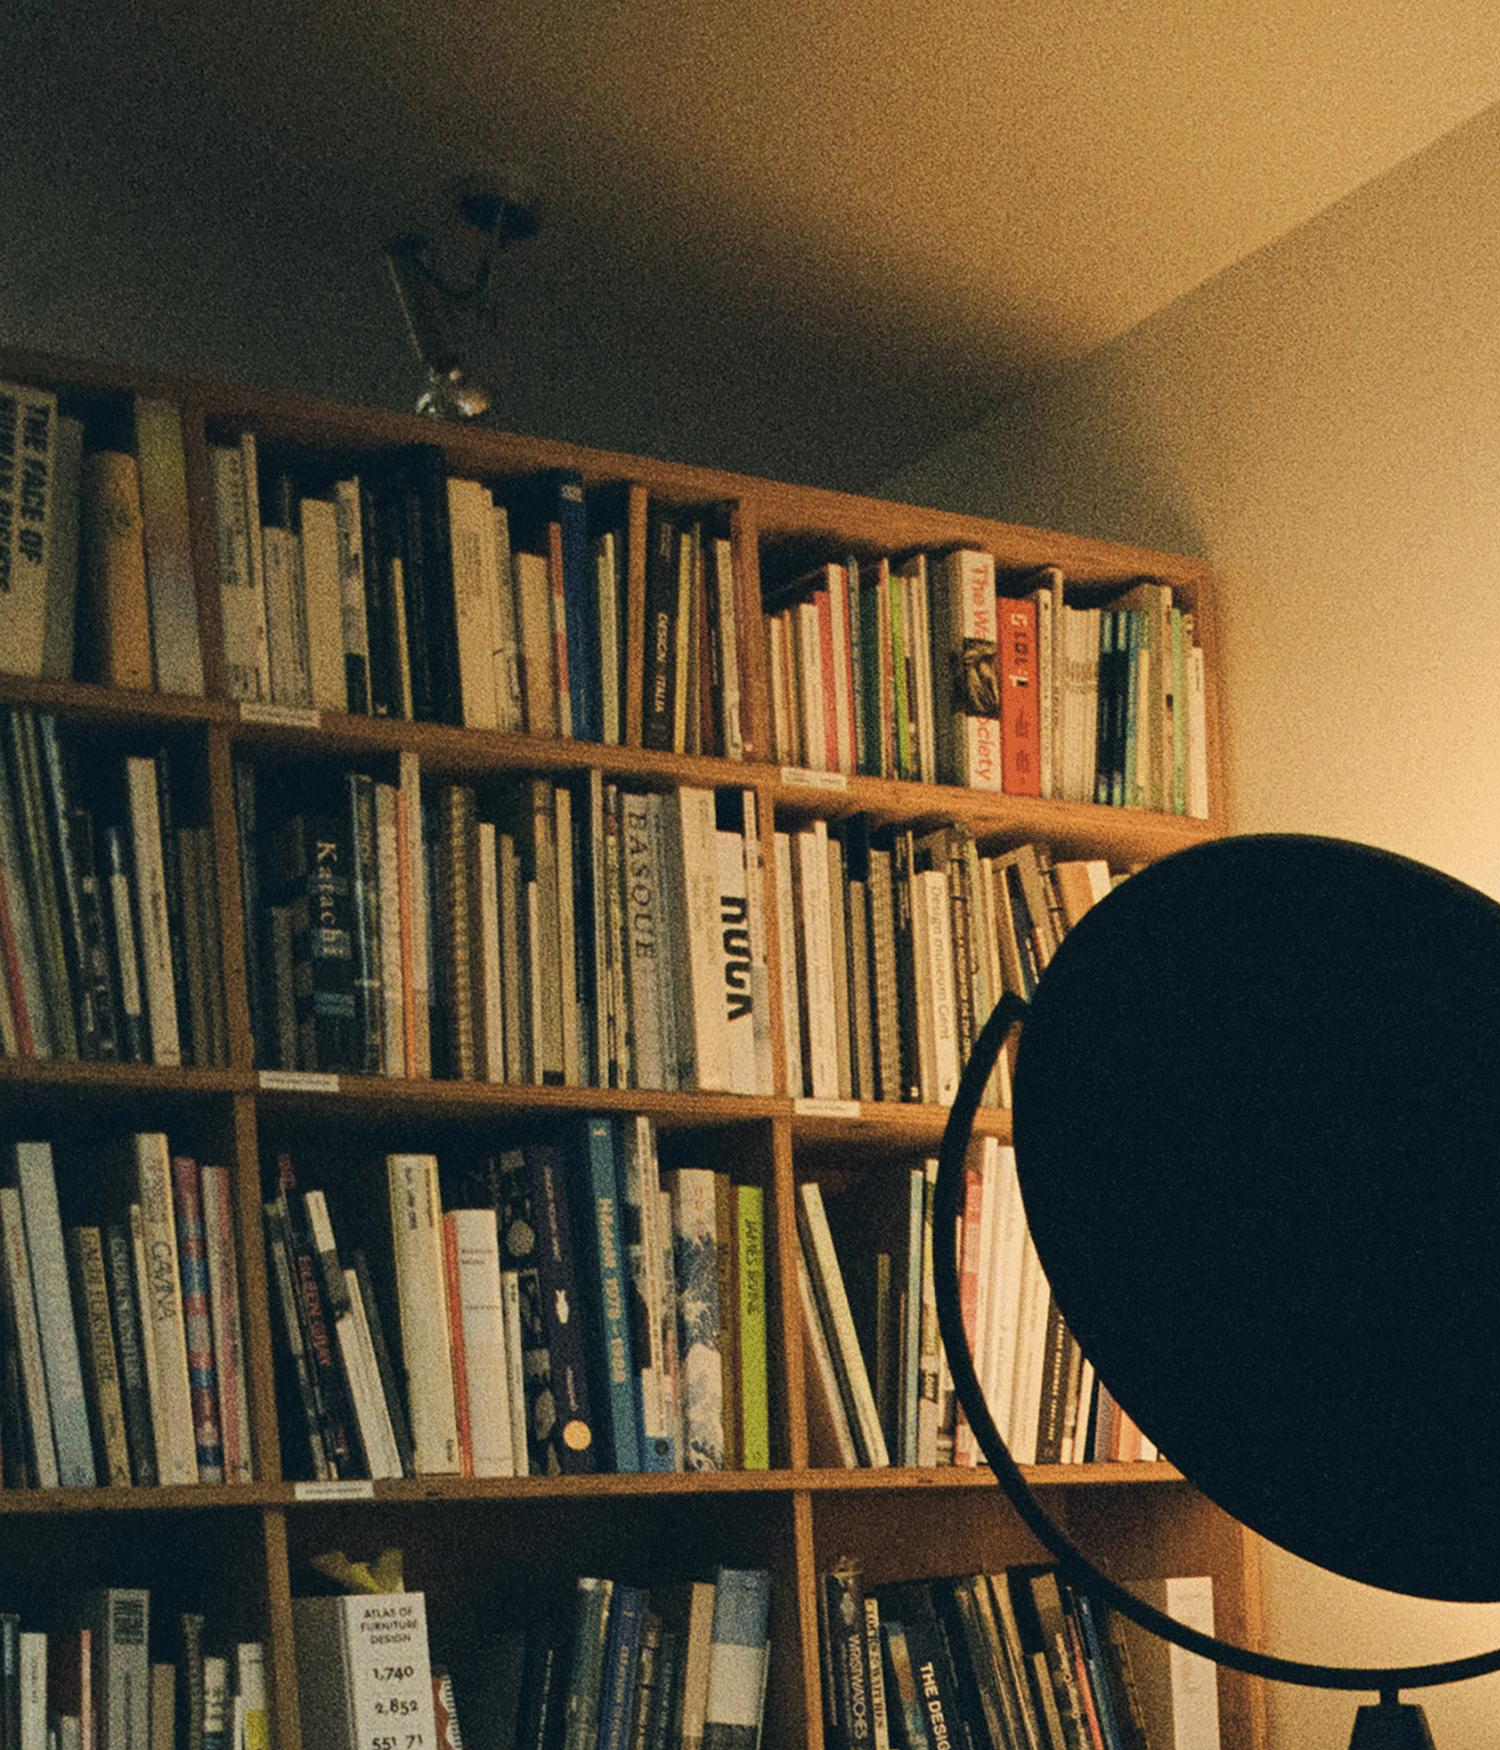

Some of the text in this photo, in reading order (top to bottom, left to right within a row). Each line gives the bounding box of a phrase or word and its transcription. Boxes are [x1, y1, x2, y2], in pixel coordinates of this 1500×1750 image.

[19, 404, 50, 565] THE FACE OF
[971, 564, 989, 607] The
[316, 841, 343, 956] Katachi
[930, 885, 950, 1040] Design museum Gent
[151, 1241, 175, 1322] GAVINA
[310, 1320, 333, 1366] GRAY
[361, 1621, 418, 1632] FURNITURE
[364, 1608, 414, 1619] ATLAS OF
[370, 1633, 412, 1644] DESIGN
[373, 1667, 414, 1681] 1,740
[847, 1634, 868, 1739] WRISTWATCHES
[918, 1661, 937, 1698] THE
[406, 1736, 423, 1750] 71
